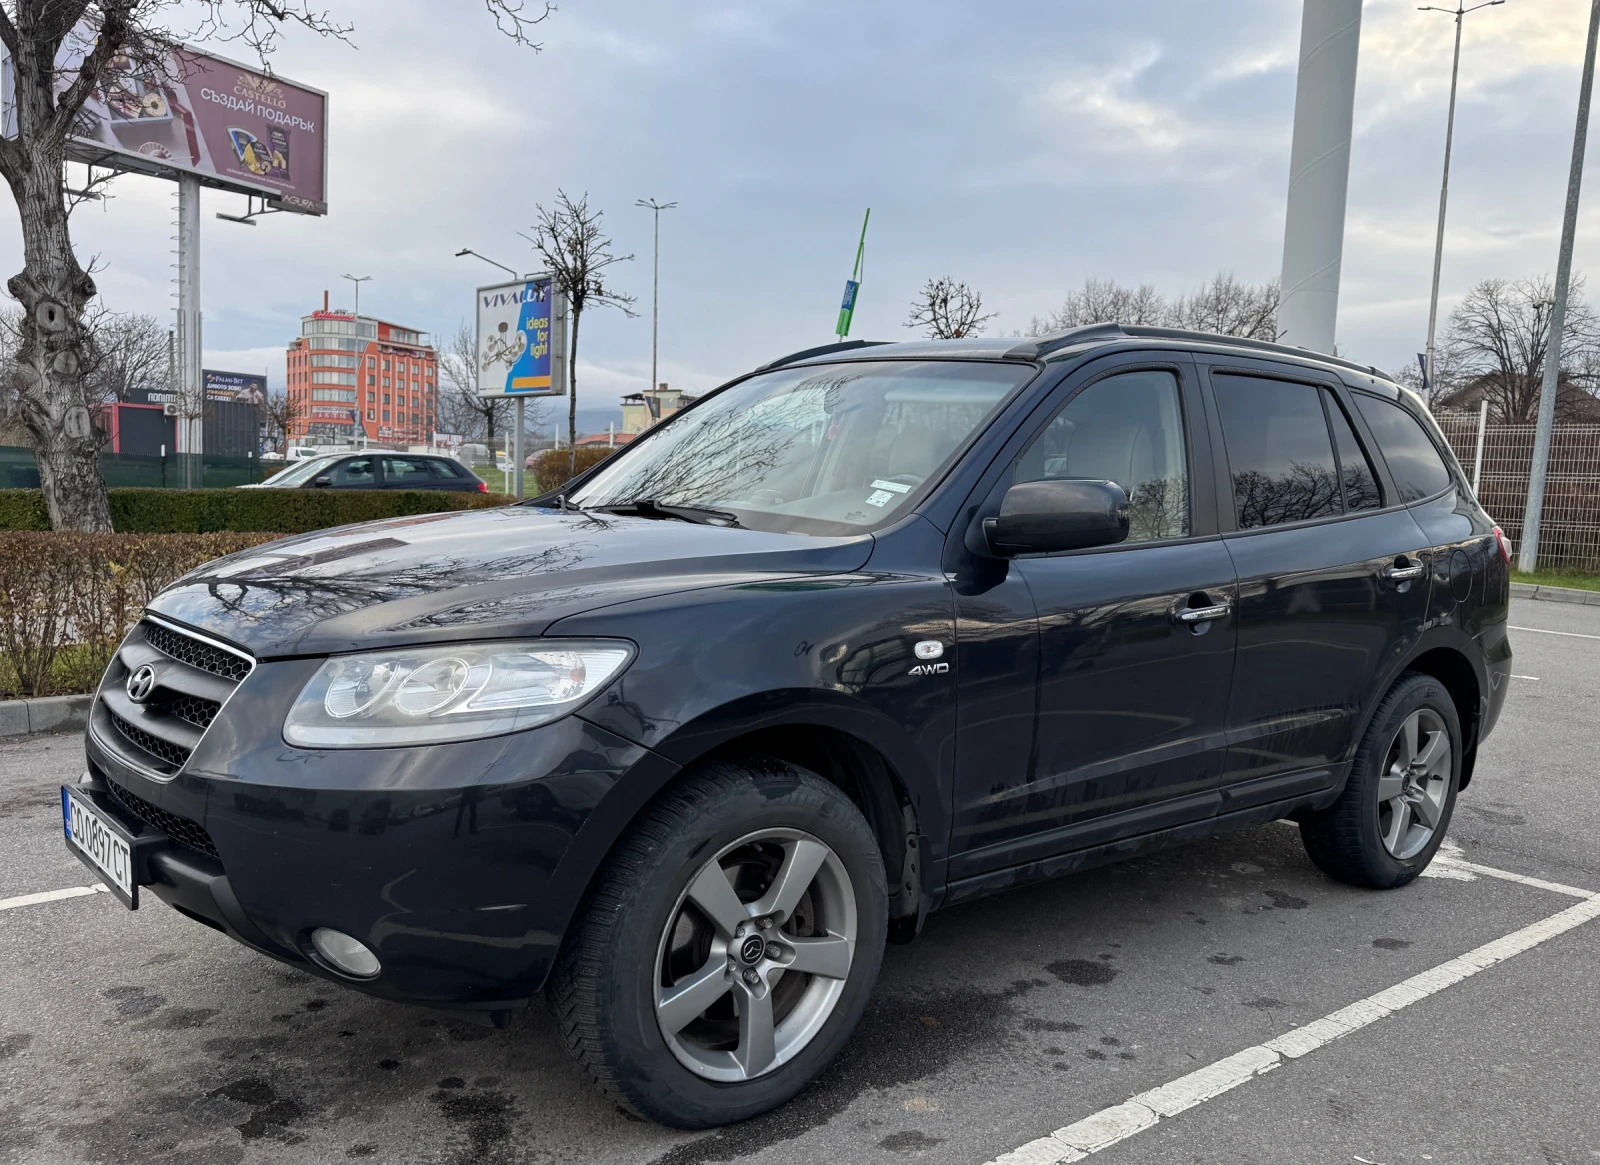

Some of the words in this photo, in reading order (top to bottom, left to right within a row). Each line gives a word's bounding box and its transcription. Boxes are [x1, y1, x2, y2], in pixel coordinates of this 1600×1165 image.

[233, 85, 287, 109] CASTELLO
[200, 87, 255, 114] СЪЗДАЙ
[257, 105, 315, 132] ПОДАРЪК
[526, 316, 549, 330] ideas
[537, 330, 549, 341] for
[530, 342, 548, 359] light
[907, 662, 949, 676] 4WD
[85, 814, 111, 869] 0897
[113, 839, 129, 888] CT
